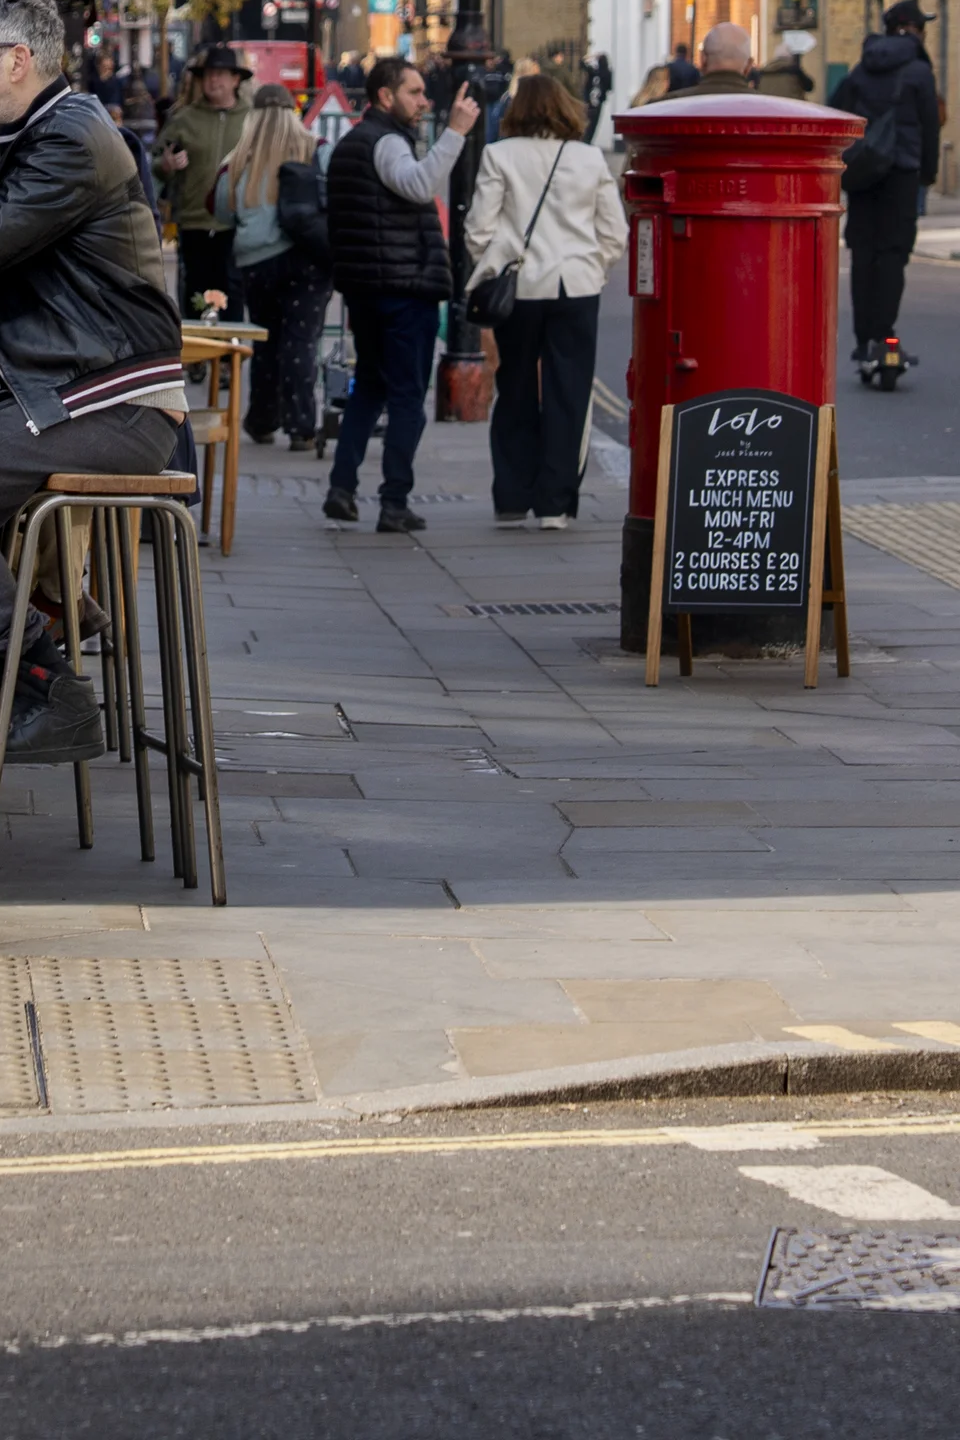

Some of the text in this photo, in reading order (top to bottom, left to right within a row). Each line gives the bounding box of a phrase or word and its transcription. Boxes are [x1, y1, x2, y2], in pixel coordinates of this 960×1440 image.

[704, 469, 780, 487] EXPRESS
[689, 489, 794, 508] LUNCH MENU
[704, 510, 775, 528] MON-FRI
[708, 531, 771, 549] 12-4PM
[674, 552, 685, 569] 2
[689, 552, 761, 570] COURSES
[673, 572, 683, 590] 3
[687, 573, 760, 591] COURSES
